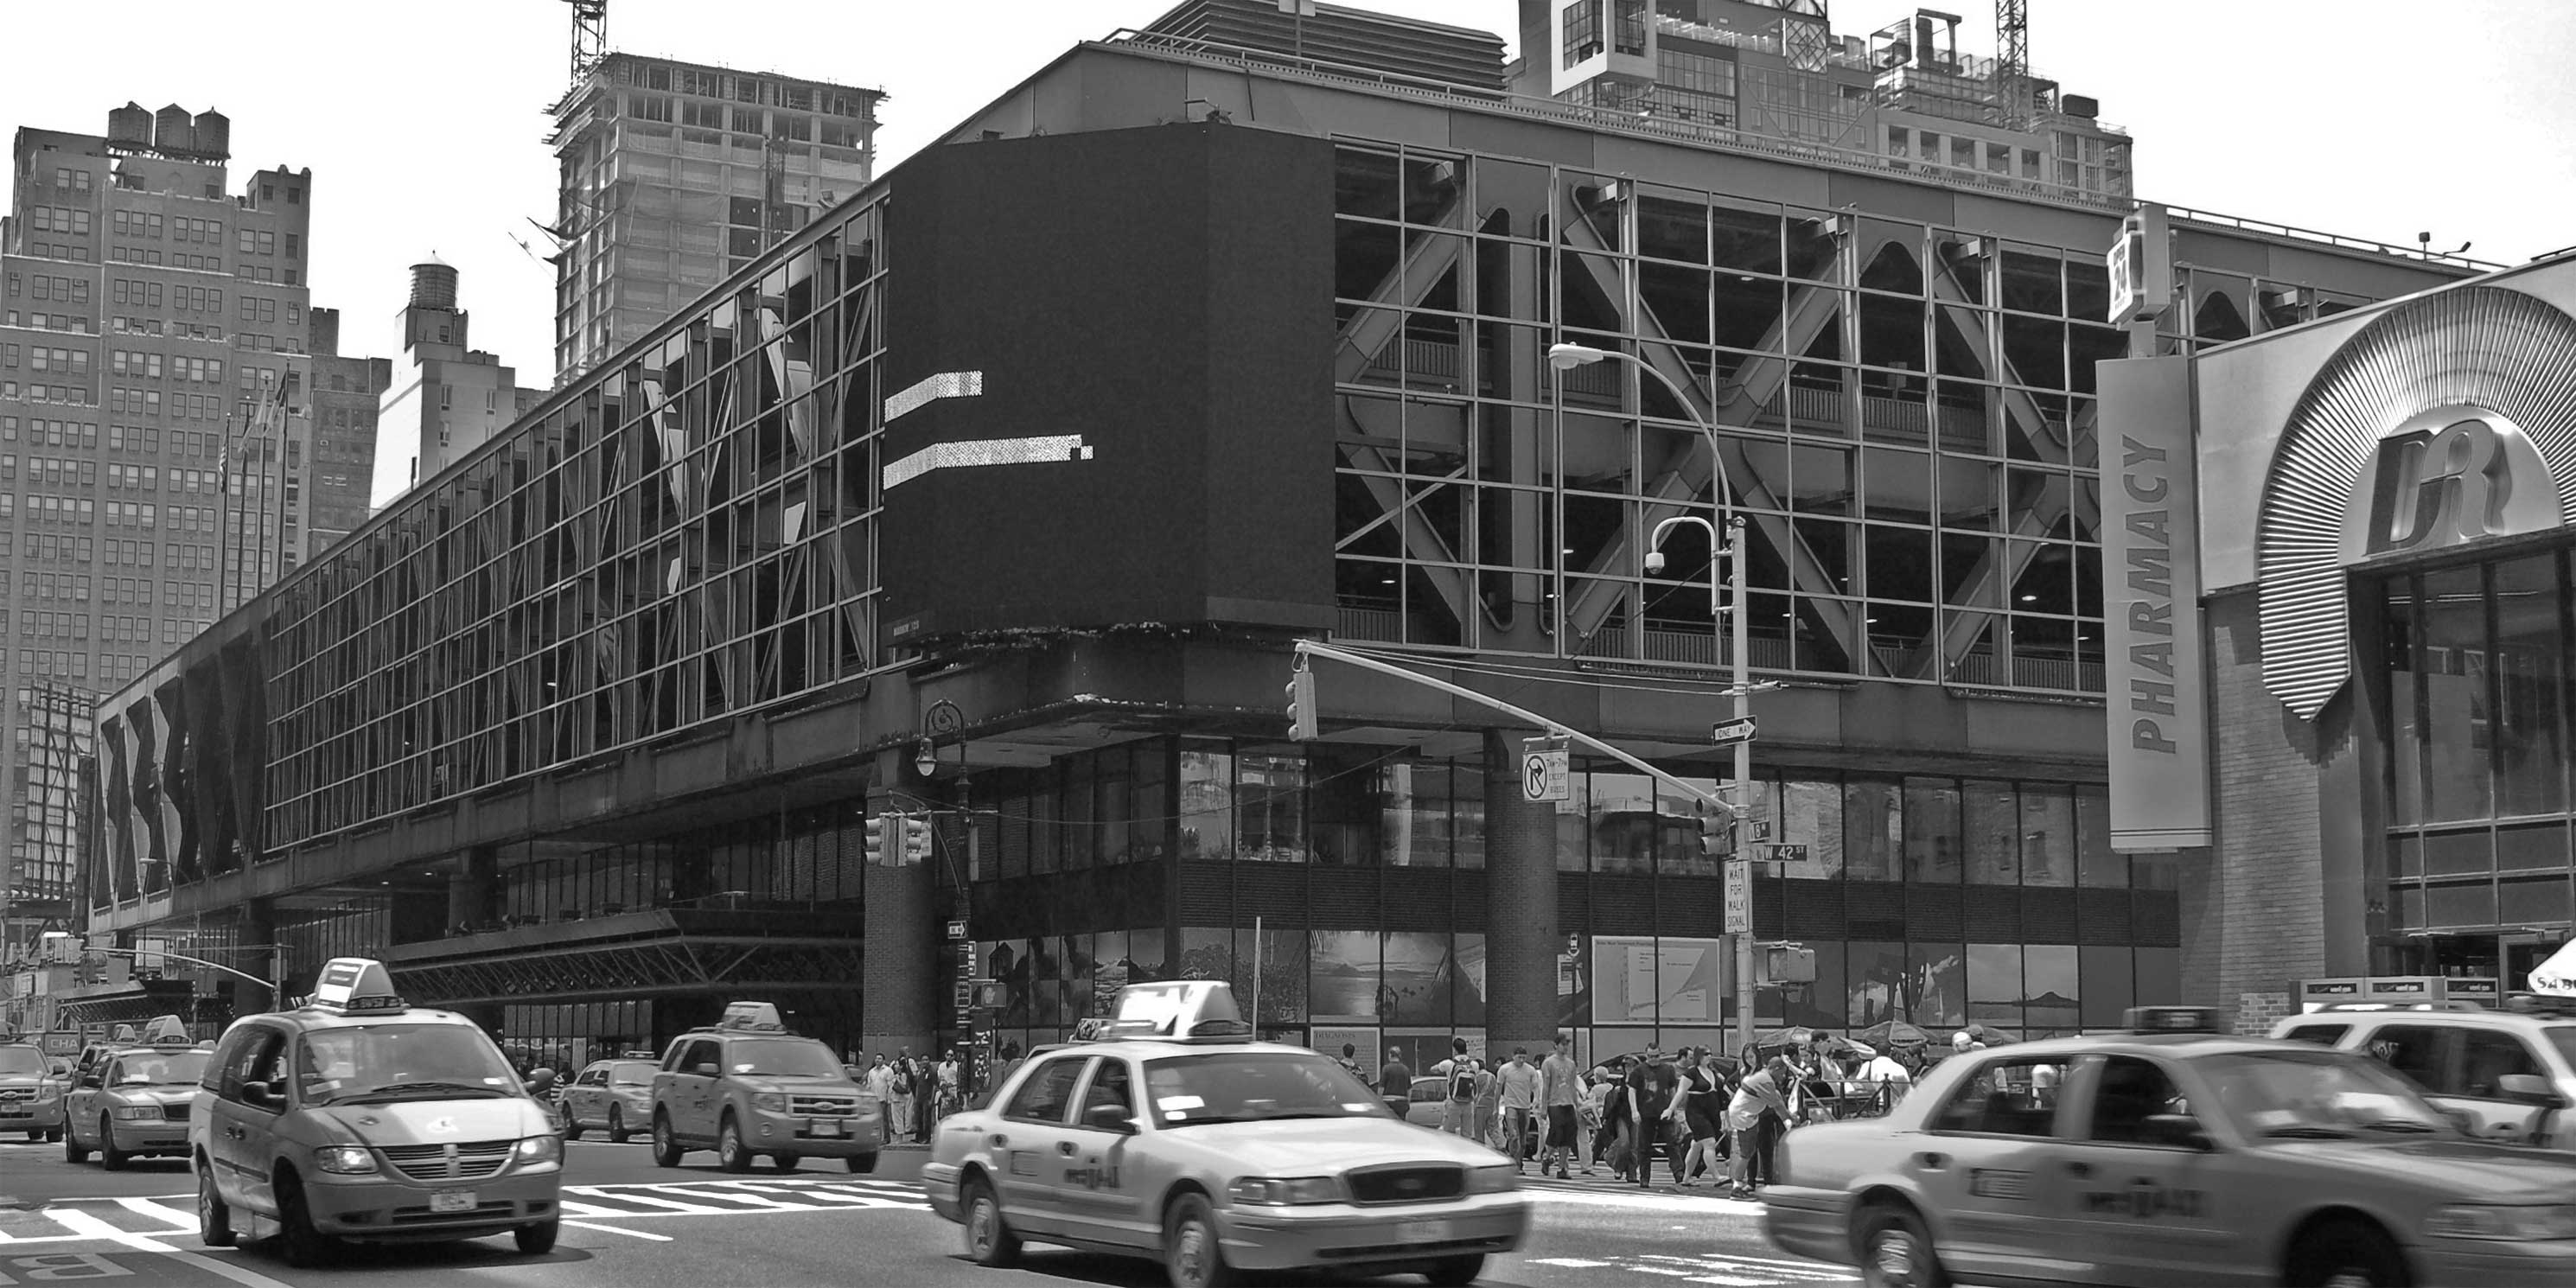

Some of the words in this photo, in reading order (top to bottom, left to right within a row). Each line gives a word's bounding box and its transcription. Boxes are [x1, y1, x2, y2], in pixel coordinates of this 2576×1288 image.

[2114, 259, 2127, 303] 24
[2121, 434, 2177, 755] PHARMACY
[1718, 727, 1731, 738] ONE
[1738, 724, 1751, 734] WAY
[1755, 824, 1761, 838] 8
[1763, 845, 1774, 859] W
[1778, 845, 1794, 860] 42
[1795, 845, 1805, 854] ST
[1729, 868, 1744, 880] WAIT
[1730, 883, 1743, 896] FOR
[1728, 899, 1745, 911] WALK
[1727, 915, 1745, 928] SIGNAL
